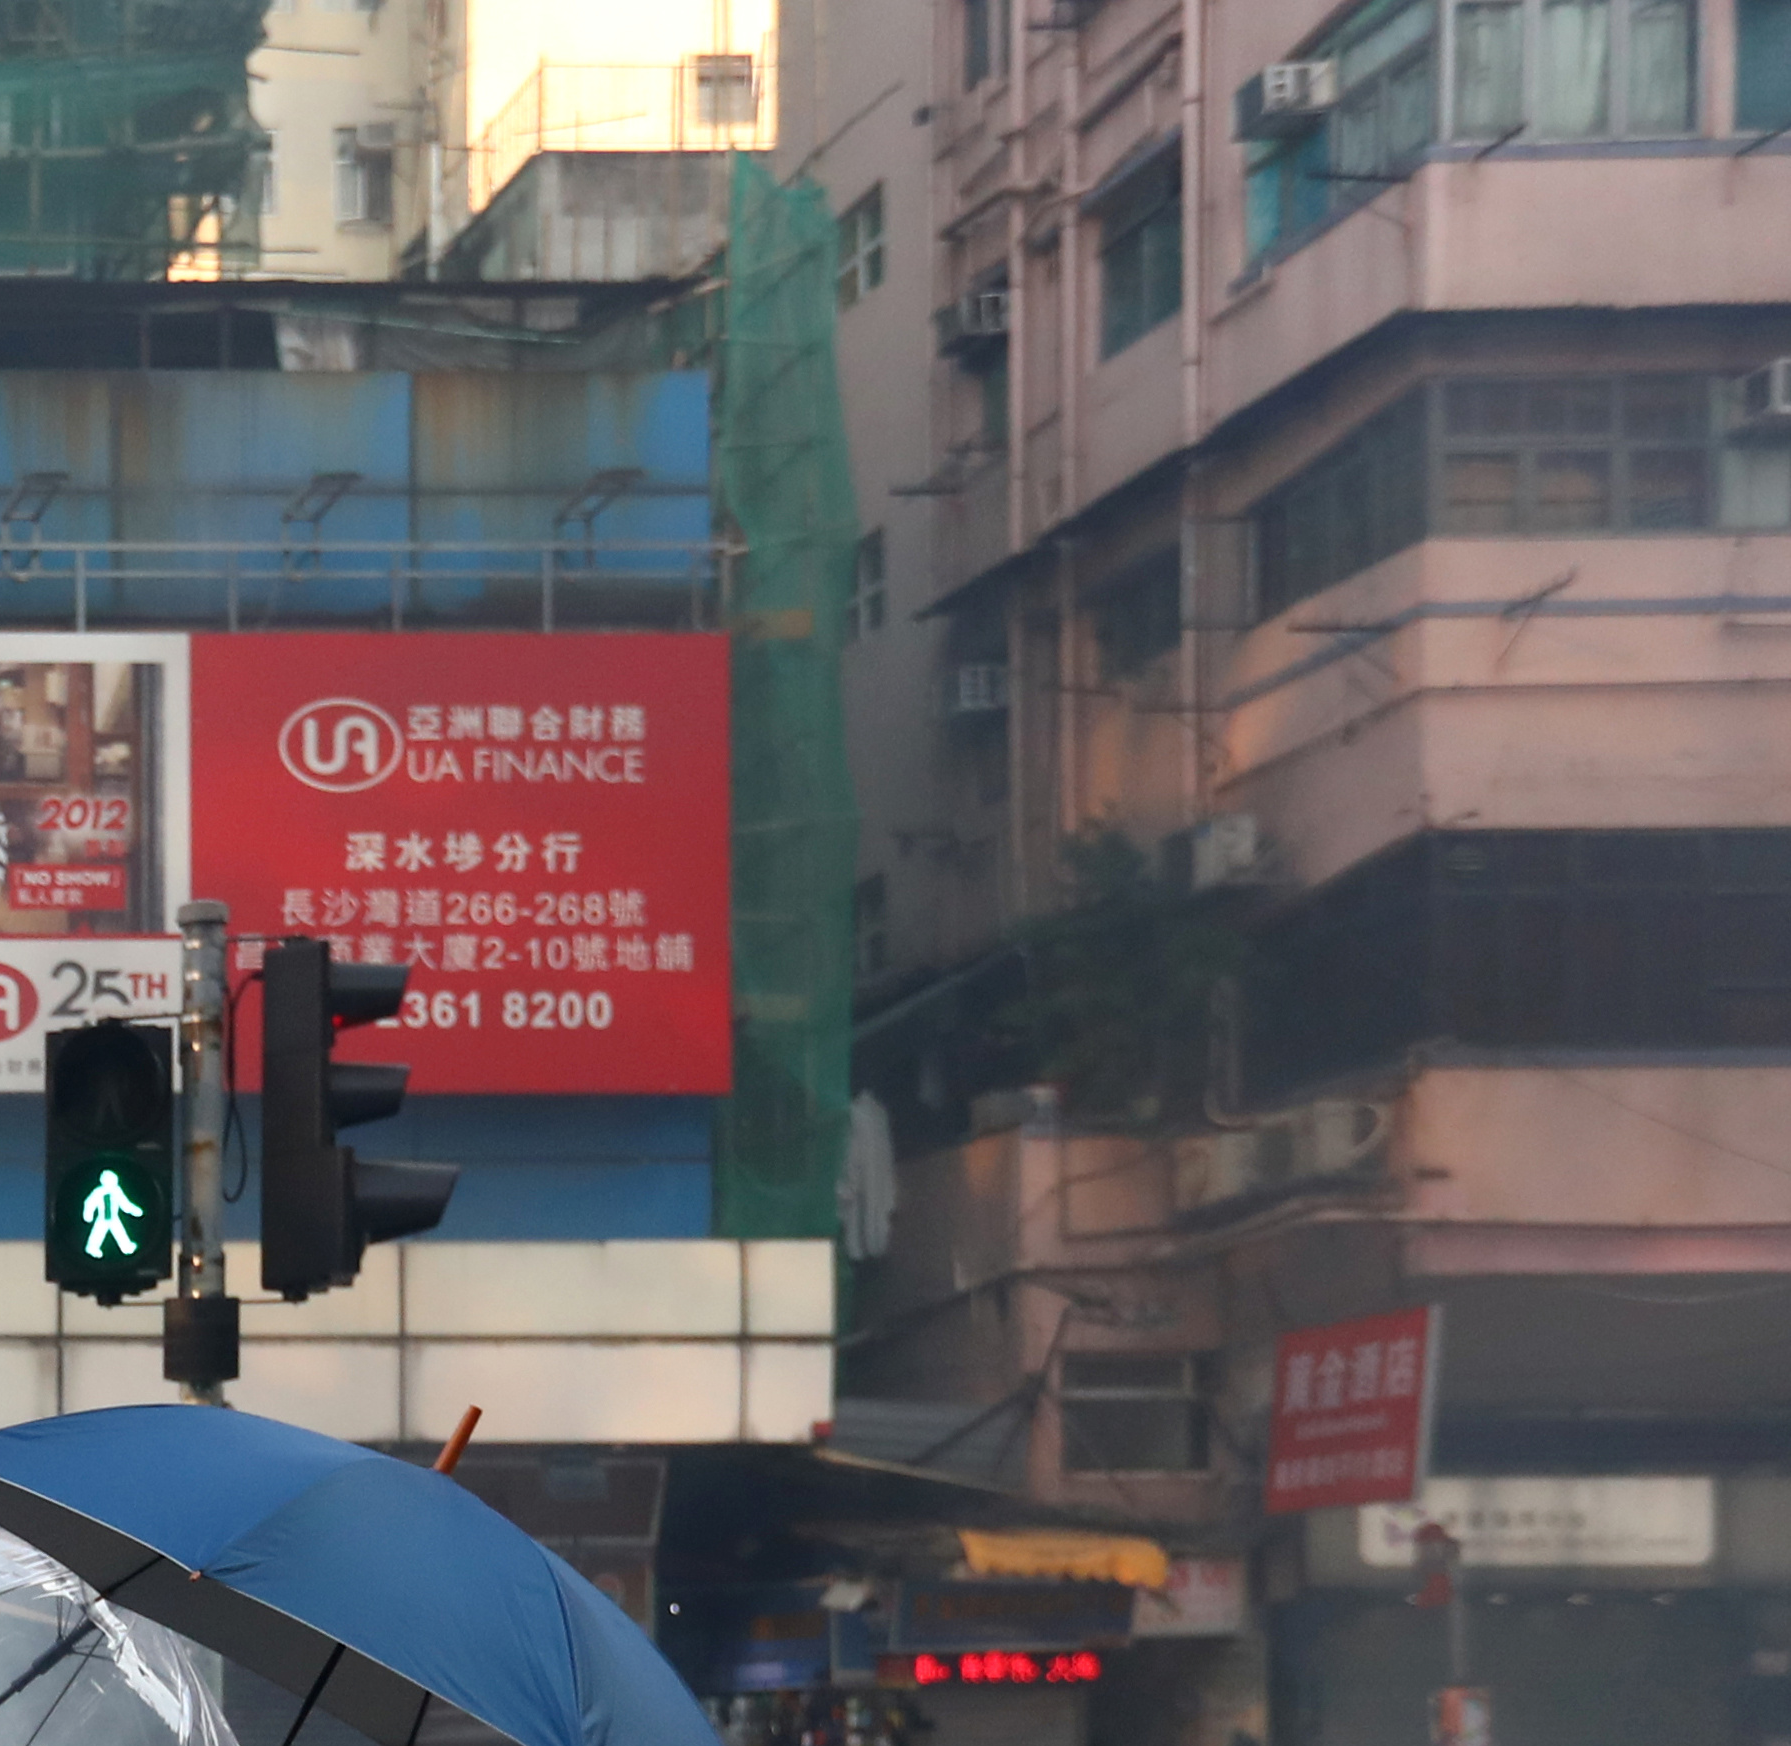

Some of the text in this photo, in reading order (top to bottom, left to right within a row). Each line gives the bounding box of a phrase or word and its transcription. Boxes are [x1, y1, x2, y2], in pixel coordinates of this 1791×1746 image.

[408, 705, 647, 742] 亞洲聯合財務
[407, 747, 646, 784] UA FINANCE
[36, 799, 130, 831] 2012
[280, 888, 649, 928] 長沙灣道266-268號
[374, 991, 614, 1029] 361 8200
